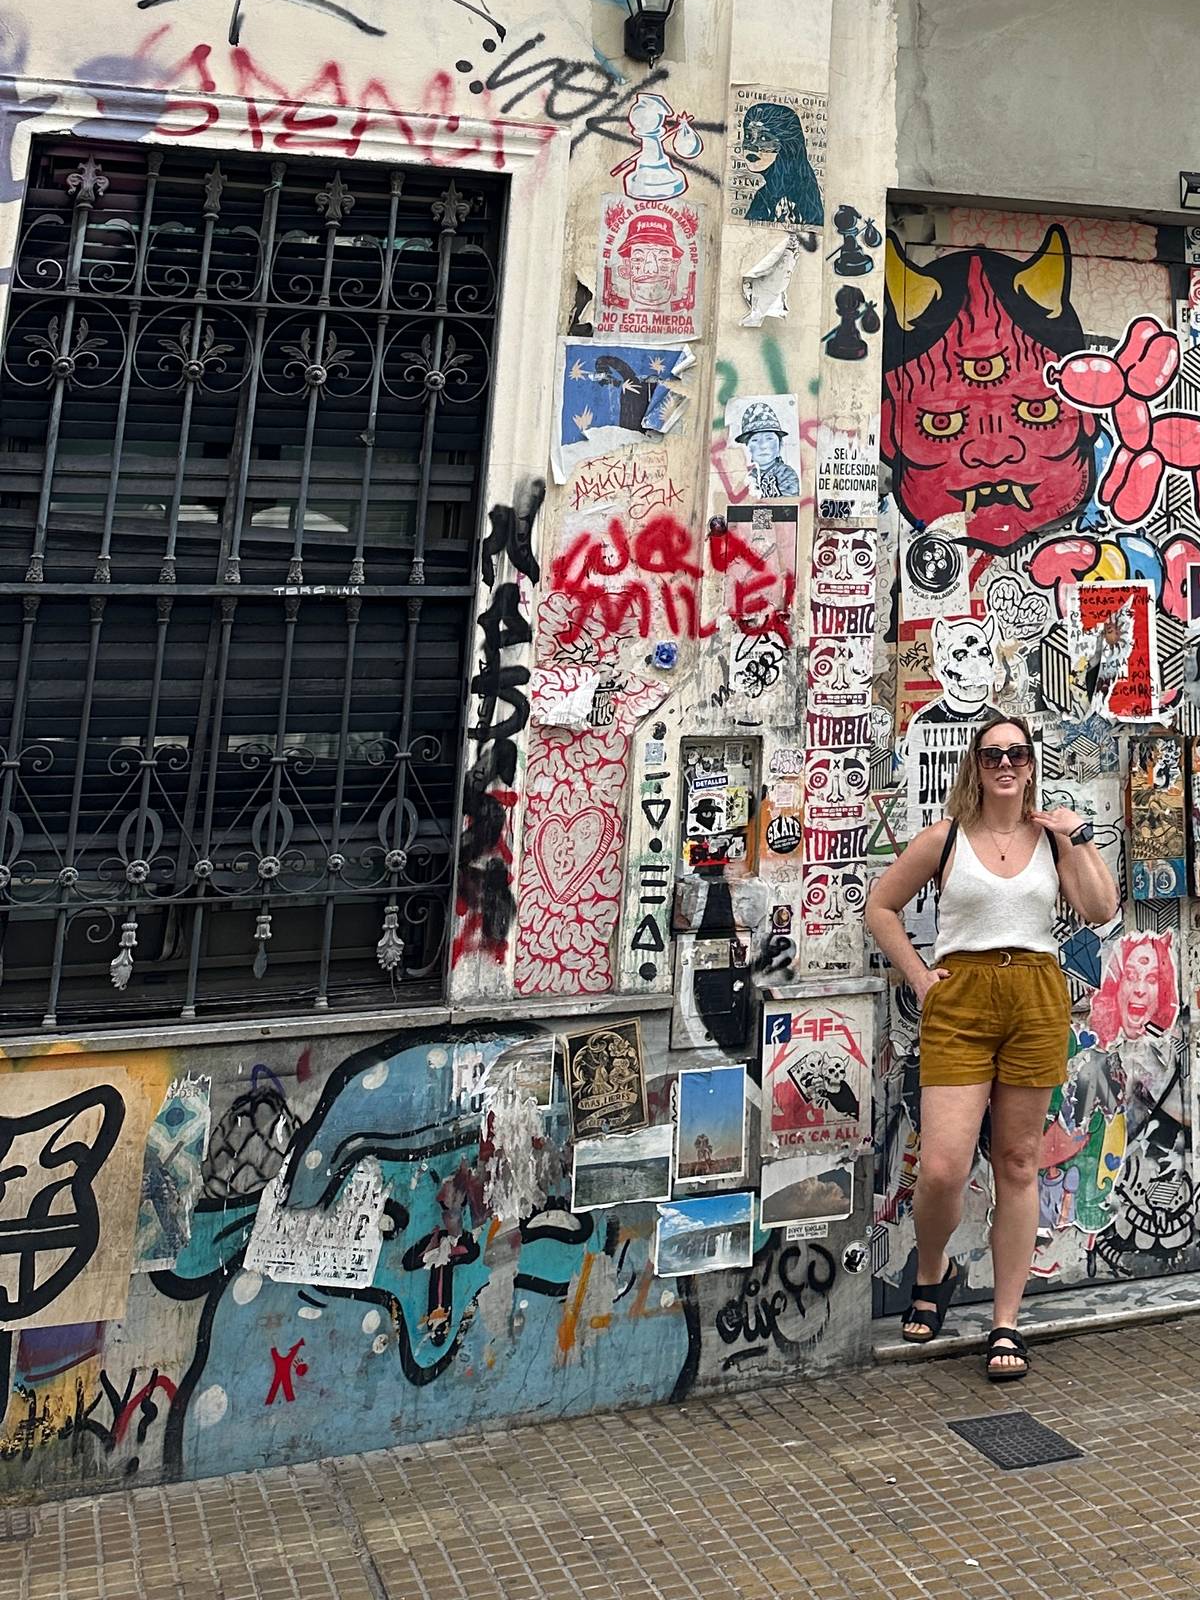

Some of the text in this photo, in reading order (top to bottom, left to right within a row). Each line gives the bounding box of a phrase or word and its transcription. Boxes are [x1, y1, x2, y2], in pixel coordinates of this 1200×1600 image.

[688, 239, 699, 266] TRAP
[602, 312, 693, 326] NO ESTA MIERDA
[597, 324, 695, 335] QUE ESCUCHAN AHORA
[820, 463, 831, 475] LA
[819, 478, 877, 491] DE ACCIONAR
[908, 581, 961, 600] POCAS PALABRAS
[767, 815, 801, 844] SKATE
[835, 1126, 860, 1140] ALL
